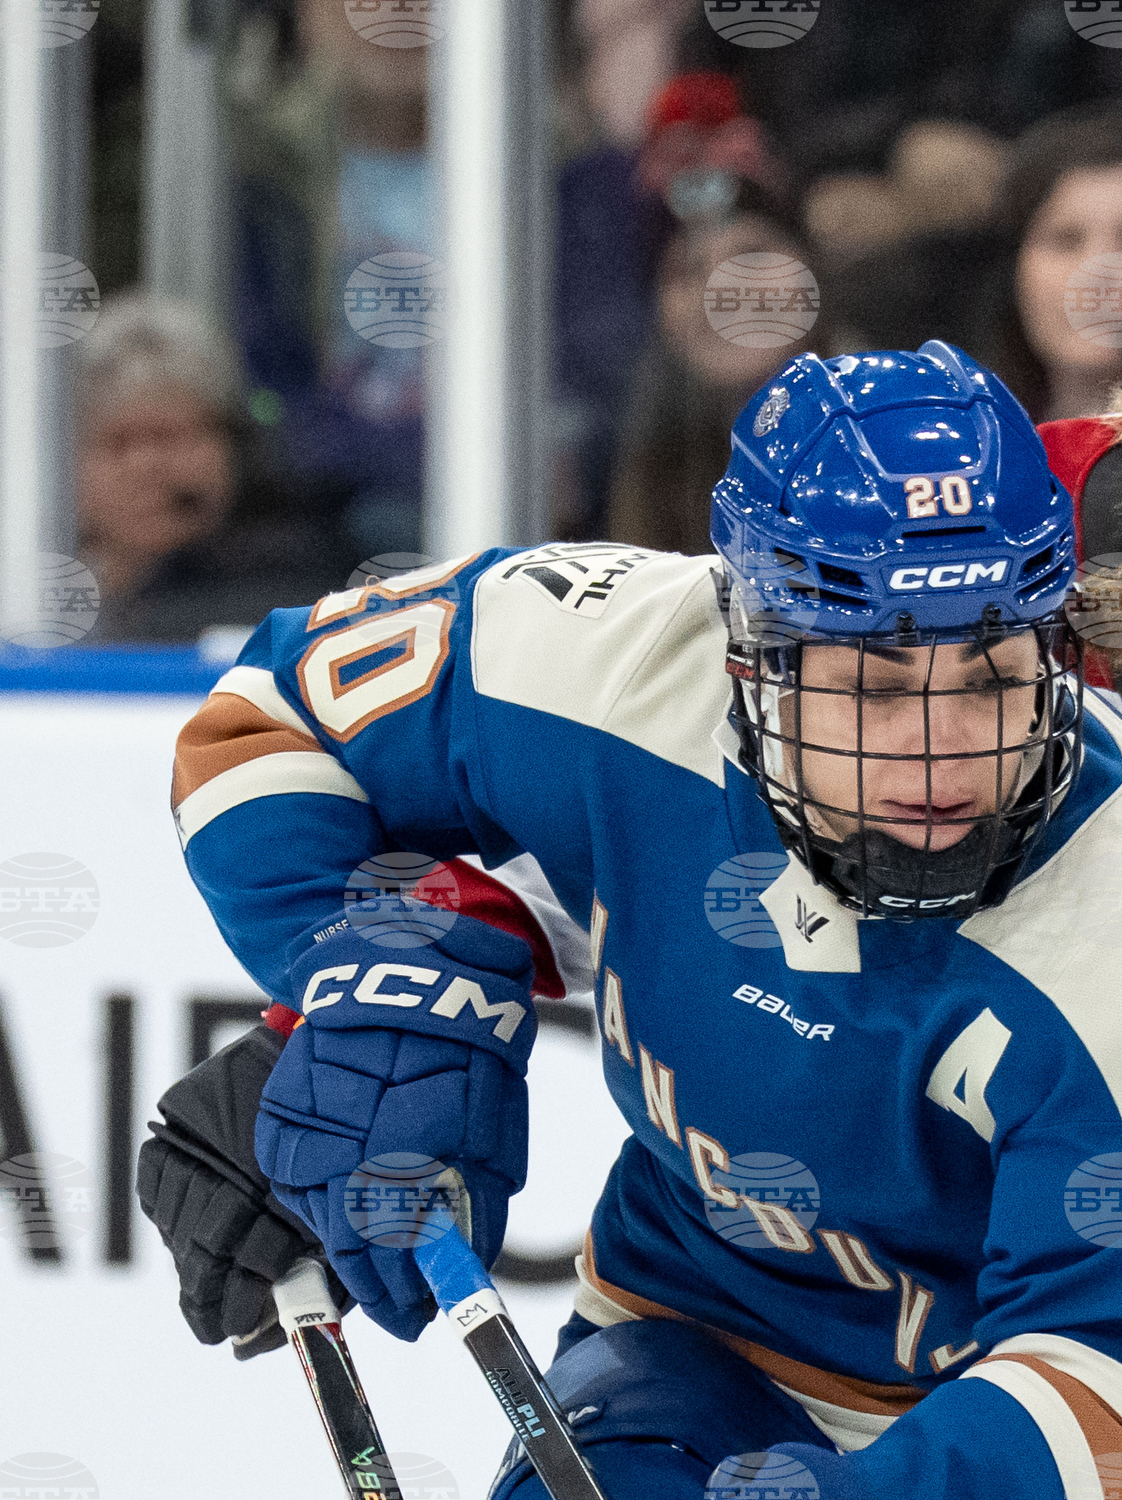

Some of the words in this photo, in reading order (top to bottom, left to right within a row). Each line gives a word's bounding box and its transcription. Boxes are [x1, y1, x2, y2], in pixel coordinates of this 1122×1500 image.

[903, 475, 972, 519] 20
[889, 560, 1008, 591] CCM
[312, 918, 350, 944] NURSE
[302, 962, 528, 1044] CCM
[925, 1006, 1012, 1143] A
